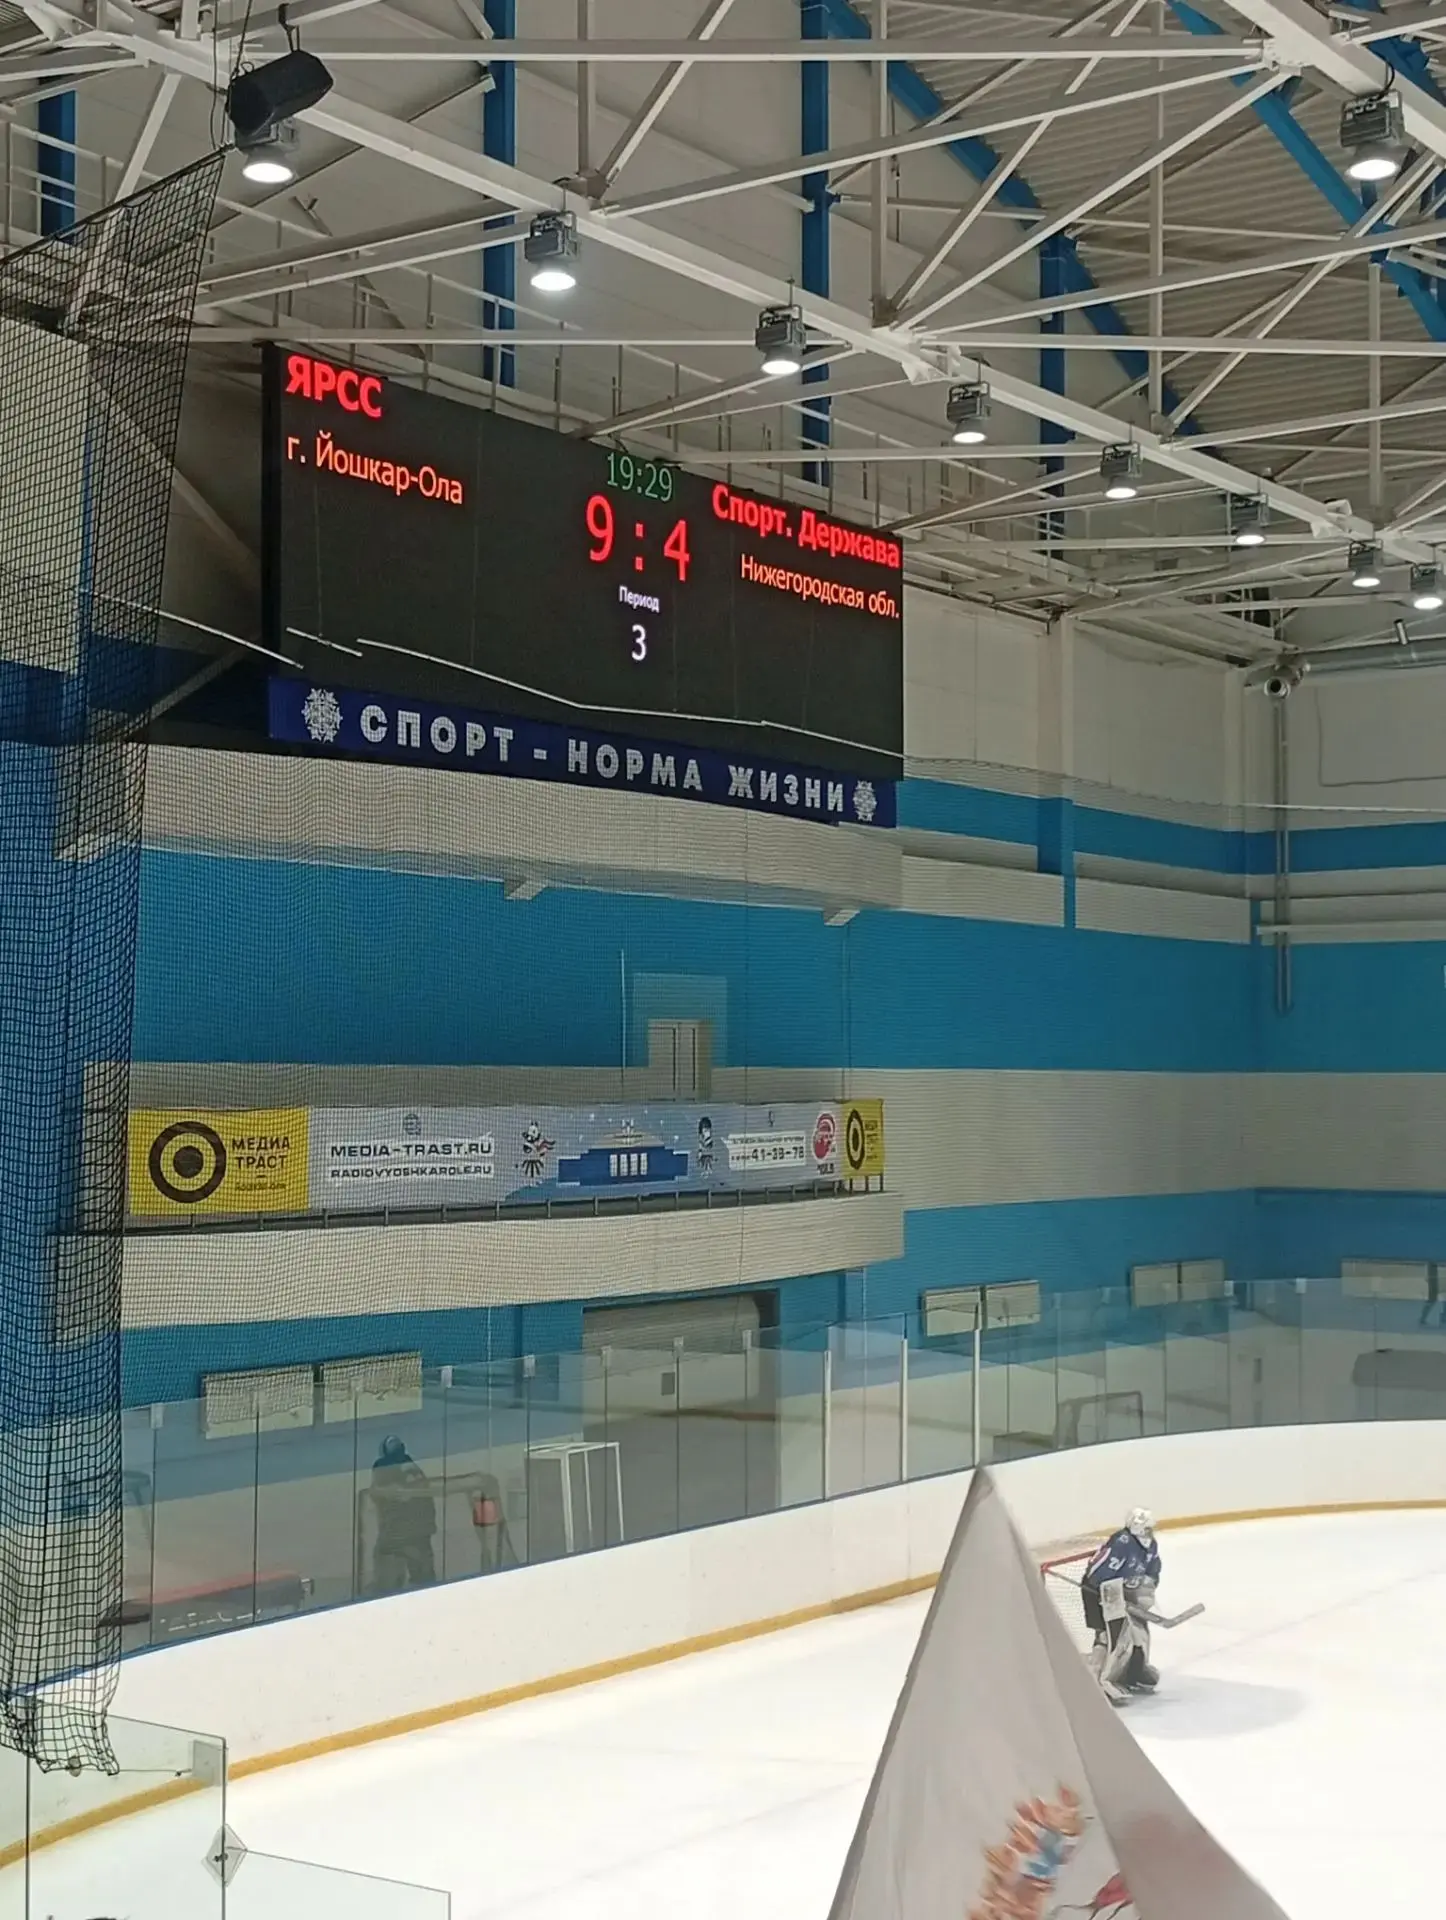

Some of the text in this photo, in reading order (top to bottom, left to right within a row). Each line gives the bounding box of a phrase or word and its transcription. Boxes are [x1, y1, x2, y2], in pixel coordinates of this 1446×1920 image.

[286, 355, 382, 418] ЯРСС
[287, 430, 463, 504] г. Йошкар-Ола
[606, 451, 673, 502] 19:29
[585, 495, 614, 561] 9
[664, 520, 690, 581] 4
[712, 484, 900, 568] Спорт. Держава
[619, 586, 660, 613] Период
[741, 554, 900, 618] Нижегородская обл.
[631, 624, 647, 661] 3
[360, 704, 514, 762] СПОРТ
[567, 739, 703, 791] НОРМА
[728, 765, 844, 812] ЖИЗНИ
[231, 1137, 290, 1150] МЕДИА
[235, 1155, 288, 1169] ТРАСТ
[331, 1143, 492, 1158] MEDIA-TRAST.RU
